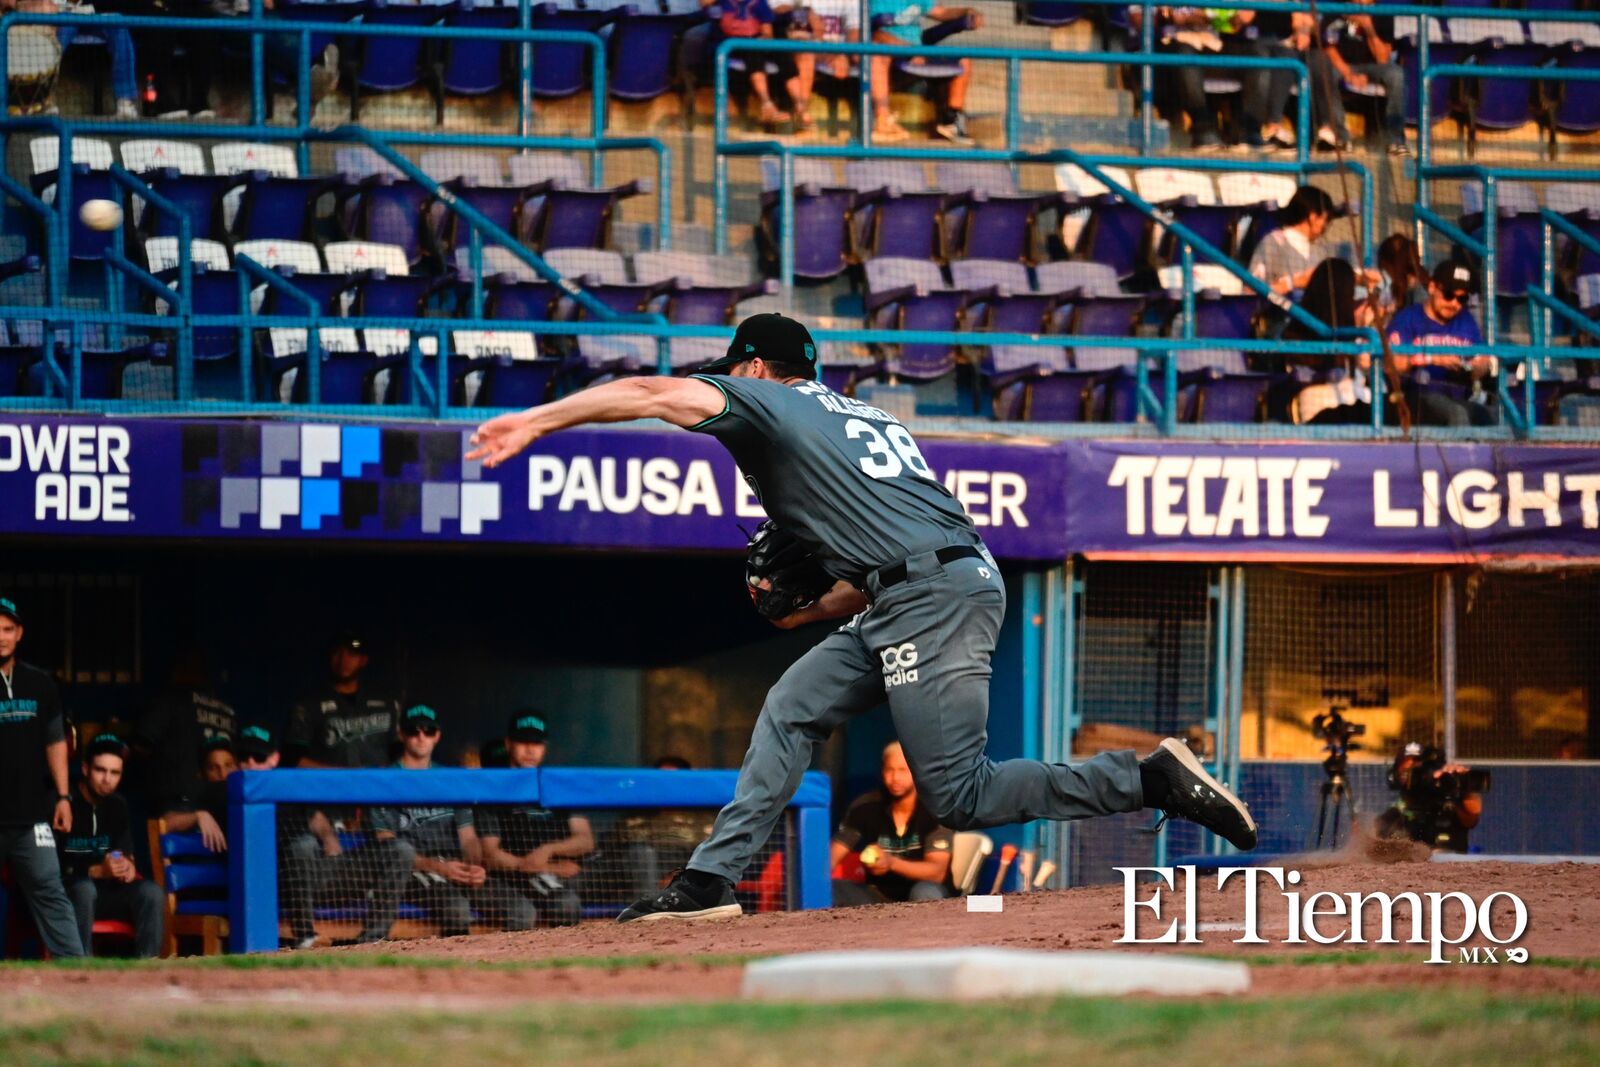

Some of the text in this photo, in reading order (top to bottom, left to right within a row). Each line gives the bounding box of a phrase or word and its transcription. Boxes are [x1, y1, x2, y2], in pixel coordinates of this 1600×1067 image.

[844, 418, 936, 481] 38
[35, 474, 130, 521] ADE
[528, 455, 723, 516] PAUSA
[1107, 457, 1600, 537] TECATE LIGHT
[885, 668, 918, 687] edia
